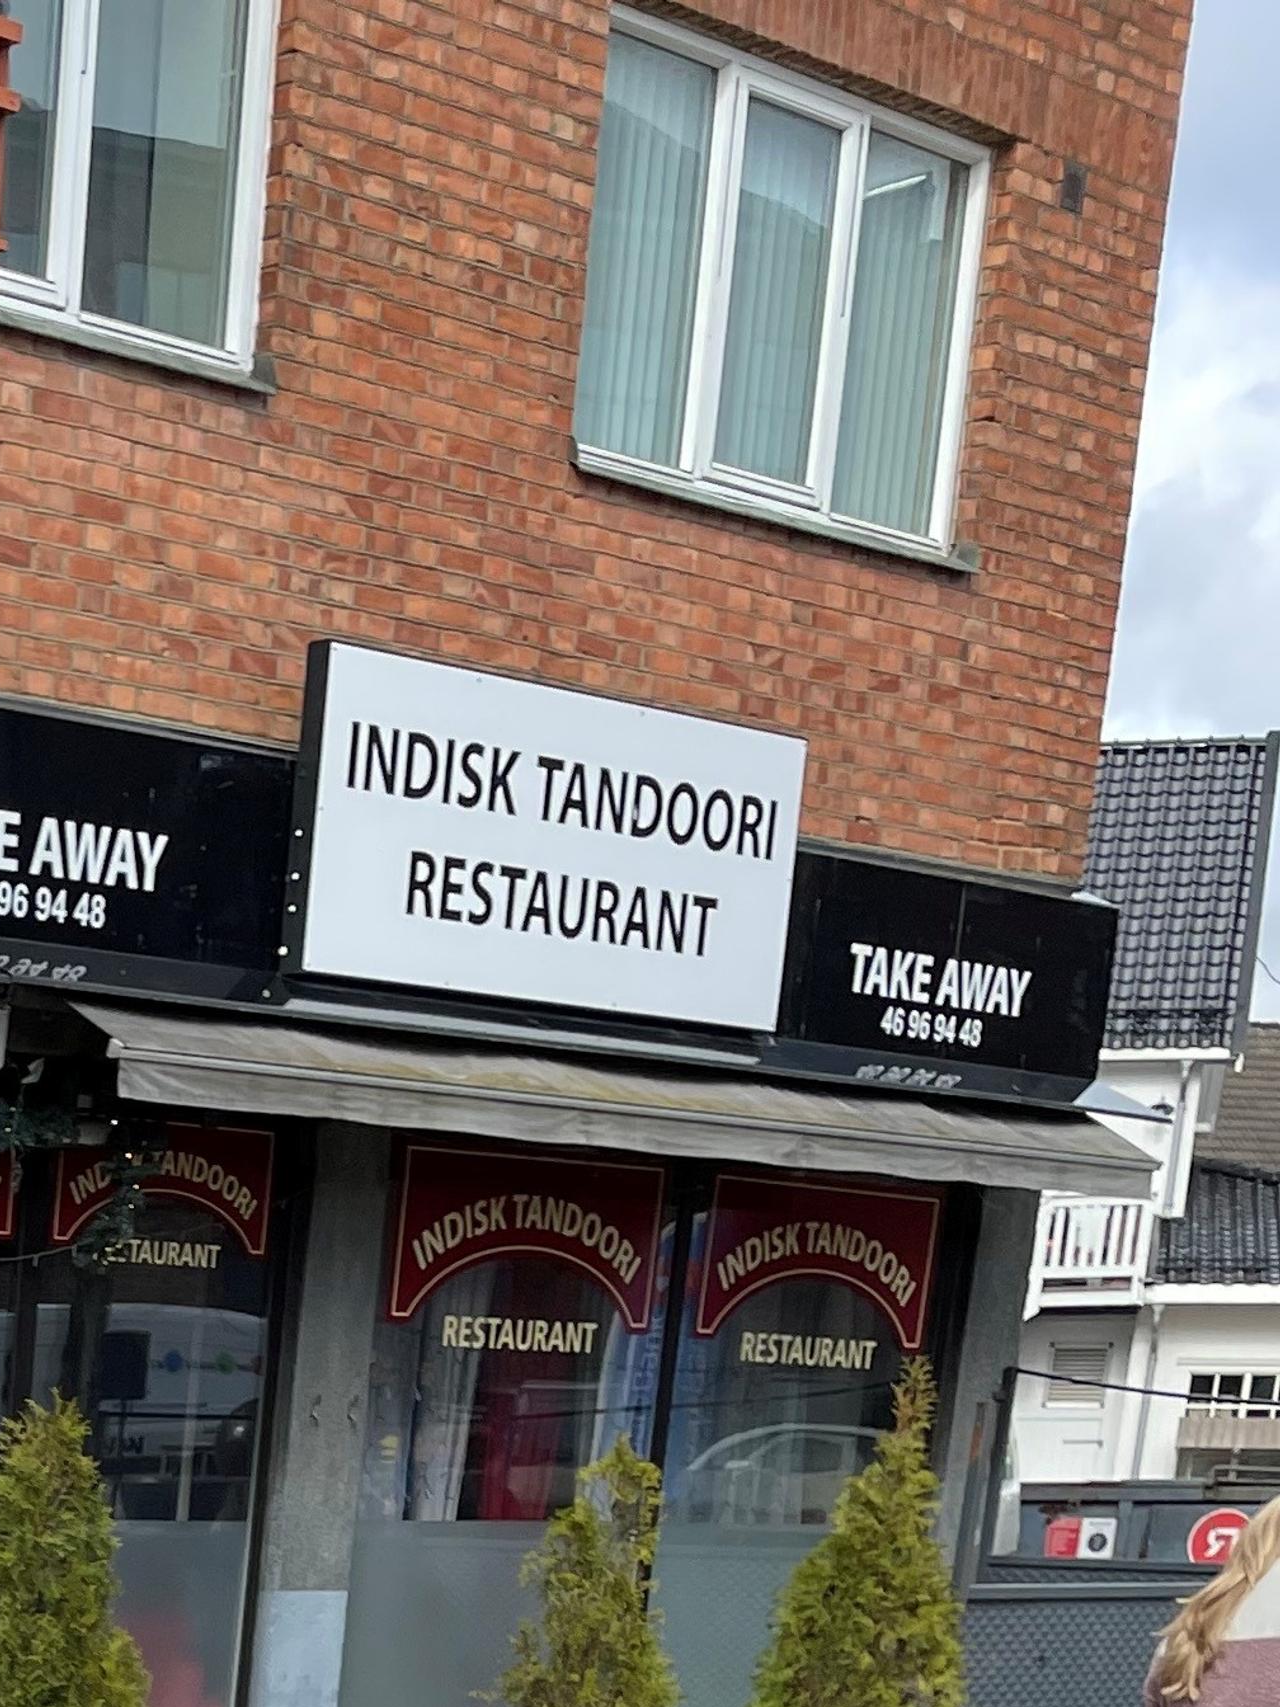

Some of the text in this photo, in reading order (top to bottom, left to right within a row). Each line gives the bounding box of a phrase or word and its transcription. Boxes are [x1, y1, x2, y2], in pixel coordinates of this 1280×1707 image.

[346, 720, 778, 861] INDISK TANDOORI
[29, 817, 169, 893] AWAY
[35, 886, 68, 924] 94
[73, 892, 106, 929] 48
[406, 851, 719, 957] RESTAURANT
[850, 942, 1032, 1017] TAKE AWAY
[880, 1006, 983, 1047] 46 96 94 48
[412, 1194, 642, 1285] INDISK TANDOORI
[717, 1221, 917, 1307] INDISK TANDOORI
[443, 1315, 598, 1353] RESTAURANT
[741, 1332, 877, 1370] RESTAURANT
